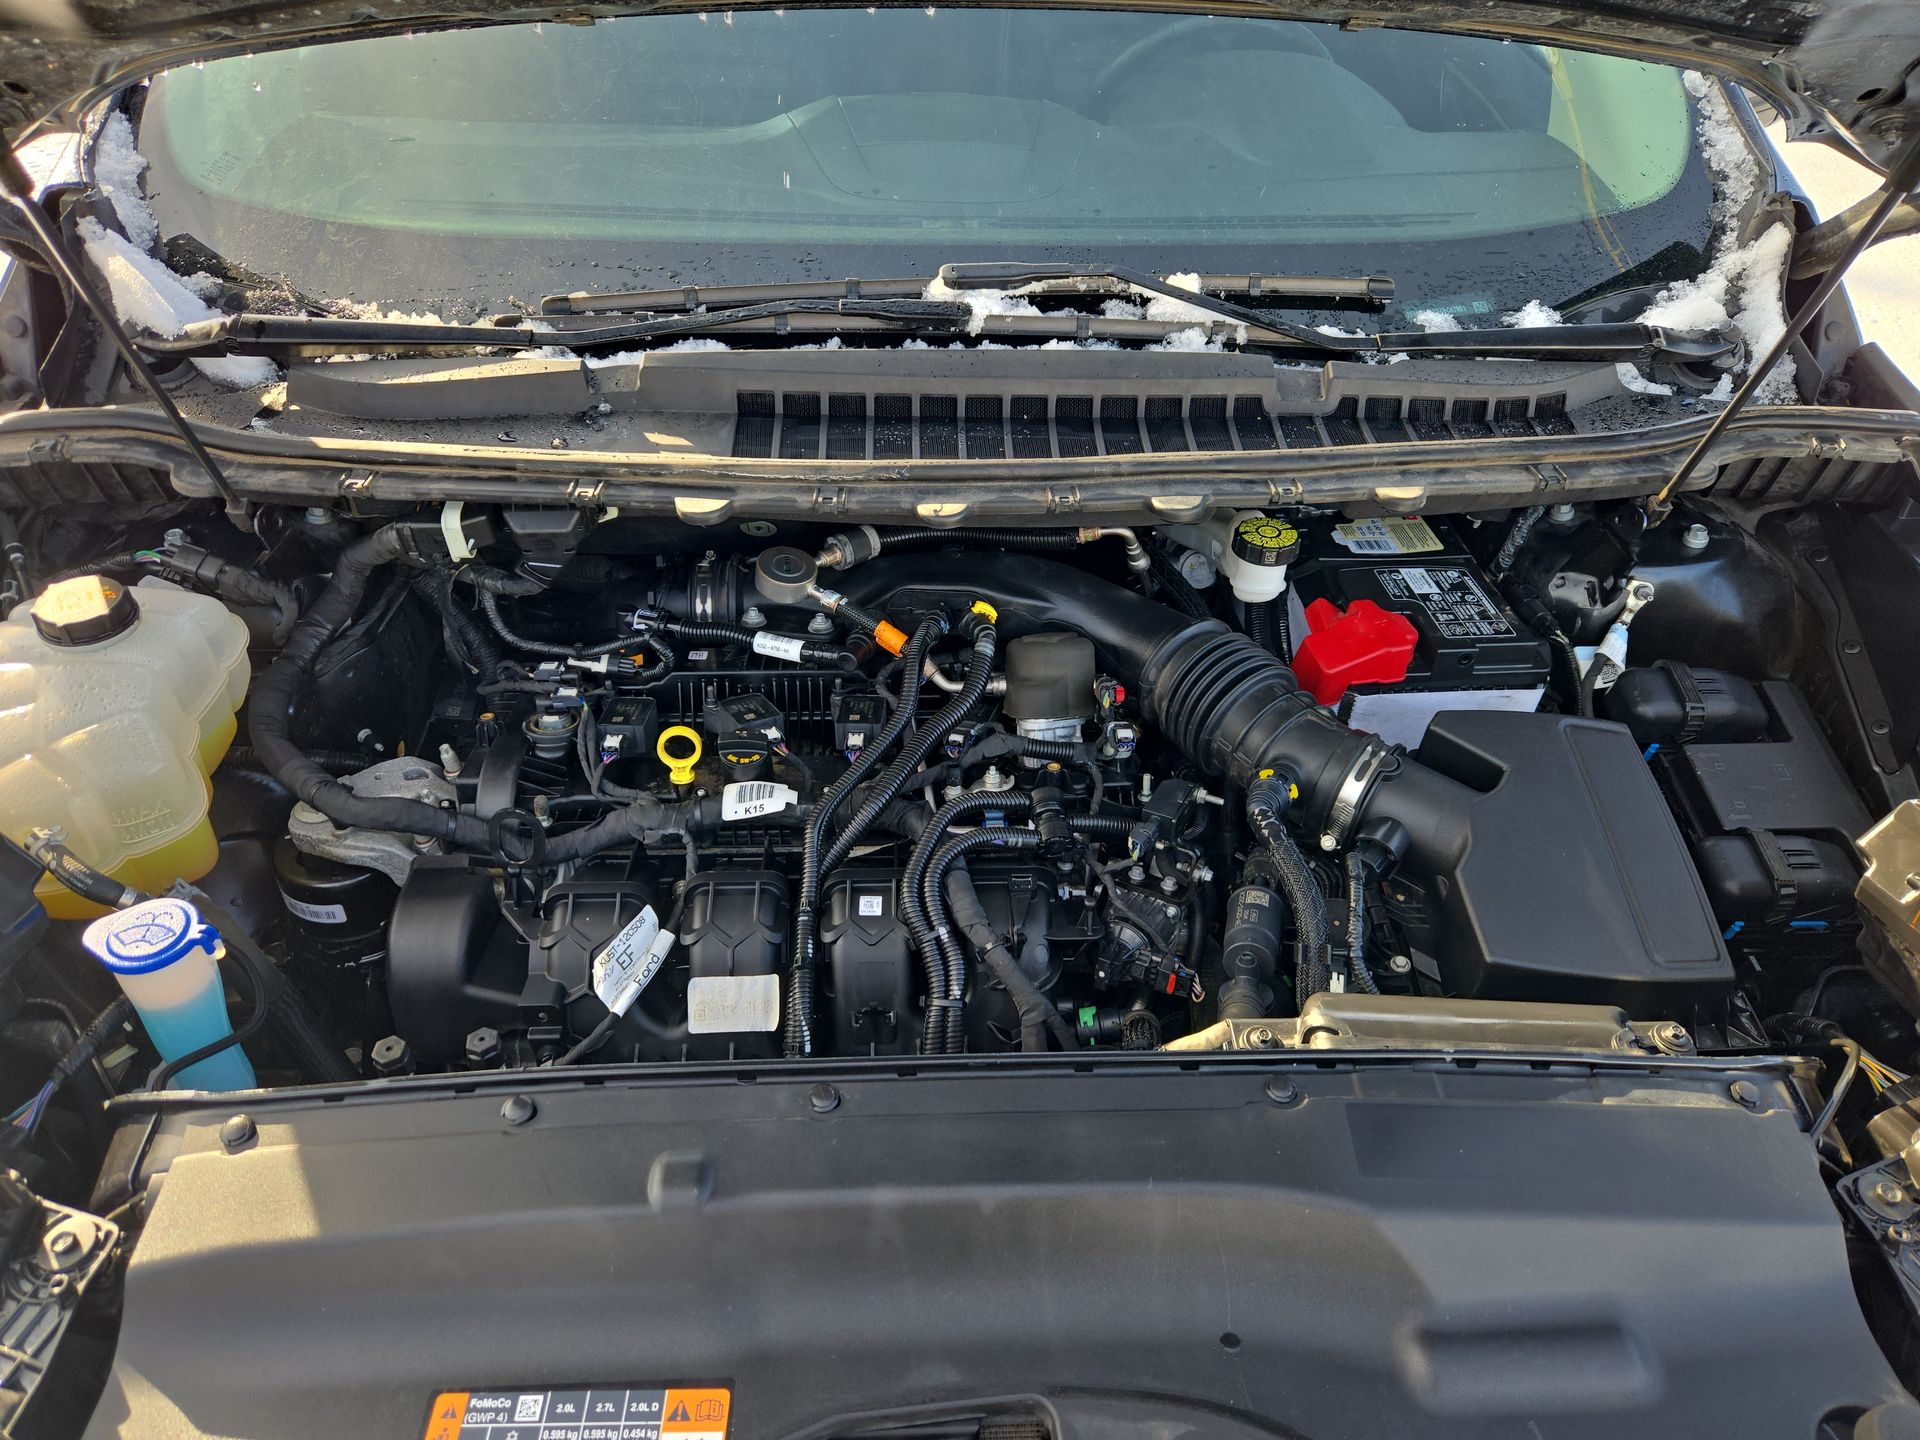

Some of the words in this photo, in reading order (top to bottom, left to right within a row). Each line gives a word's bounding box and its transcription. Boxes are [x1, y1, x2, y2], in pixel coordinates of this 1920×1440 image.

[744, 804, 765, 816] K15
[615, 943, 634, 971] EF
[633, 953, 661, 987] Ford
[469, 1398, 512, 1409] FoMoCo
[555, 1403, 576, 1413] 2.0L
[595, 1402, 616, 1413] 2.7L
[630, 1402, 650, 1413] 2.0L
[651, 1402, 660, 1412] D
[464, 1412, 495, 1425] (GWP
[496, 1412, 508, 1425] 4)
[542, 1429, 566, 1440] 0.595
[567, 1429, 579, 1440] kg
[607, 1429, 619, 1440] kg
[623, 1428, 646, 1439] 0.454
[647, 1428, 659, 1440] kg
